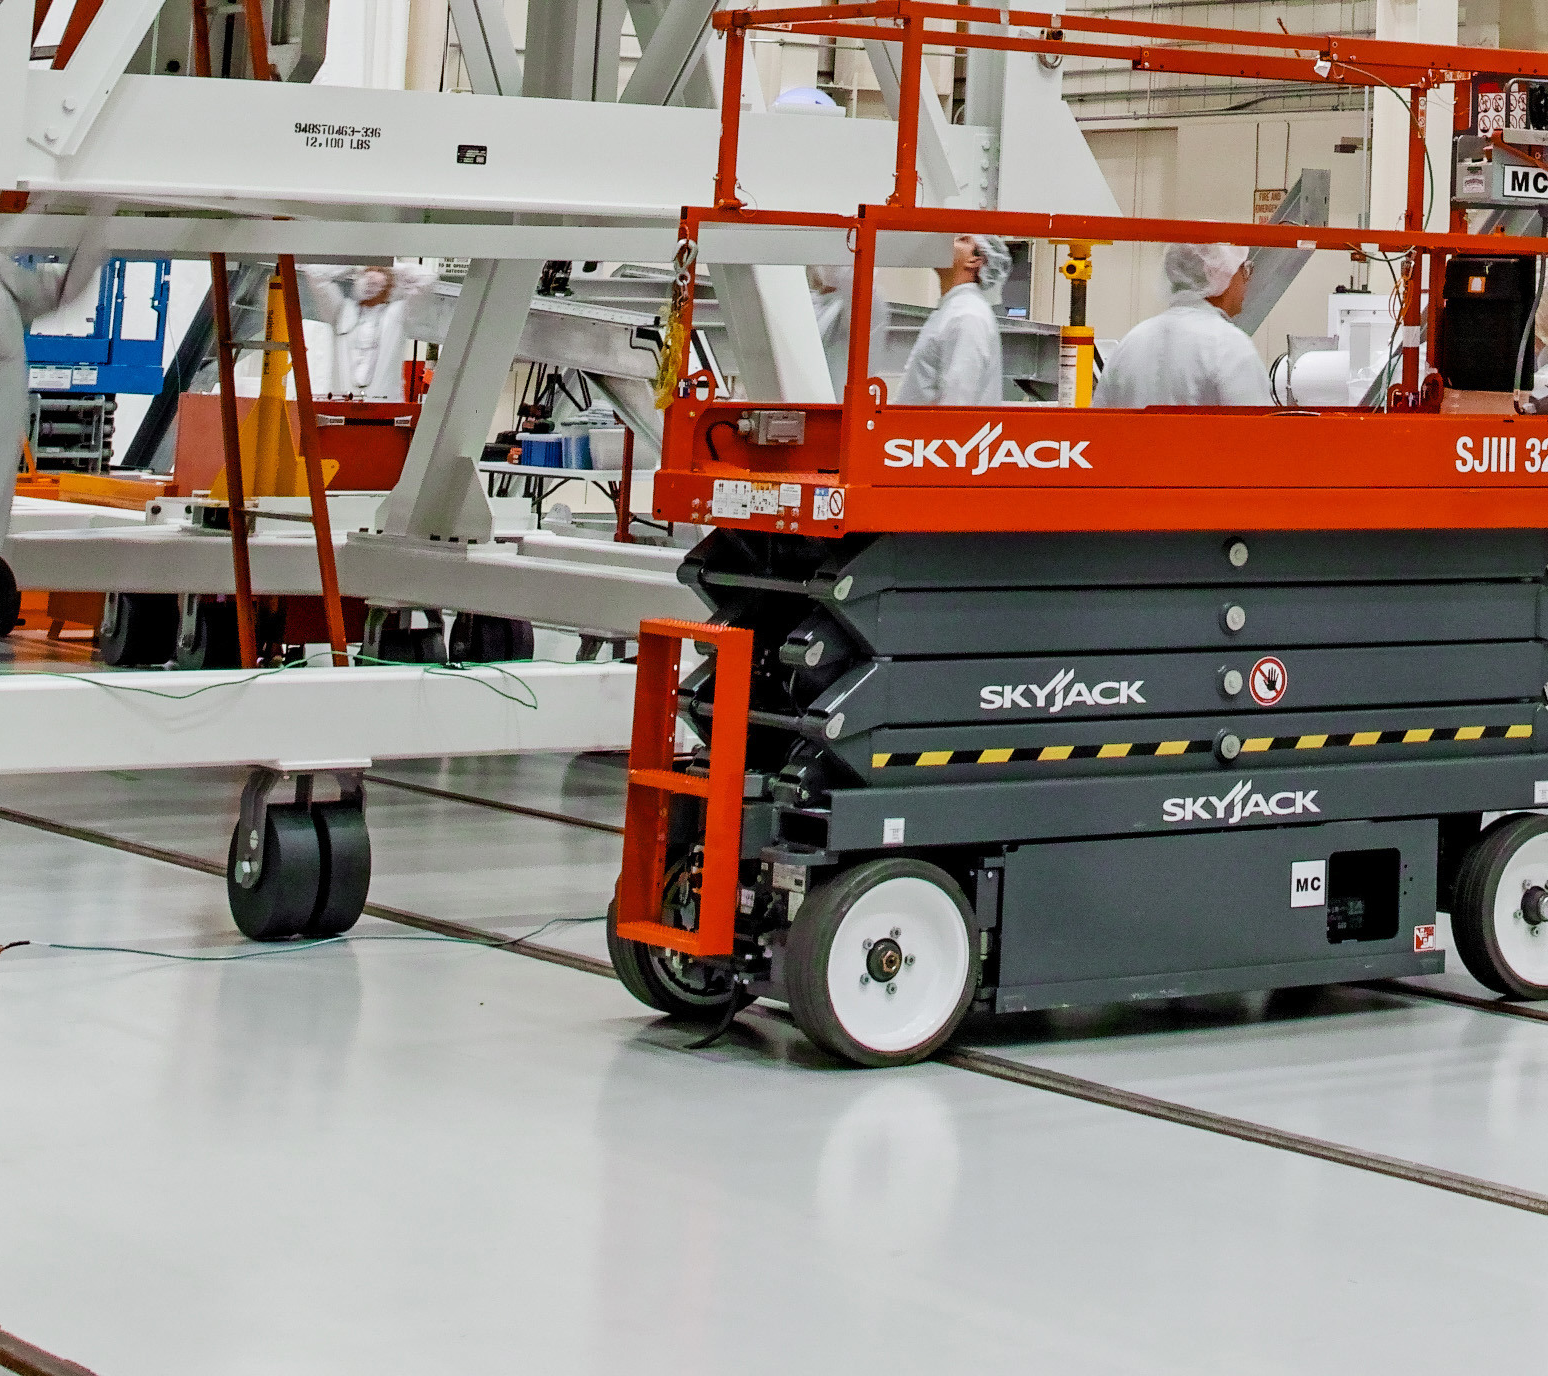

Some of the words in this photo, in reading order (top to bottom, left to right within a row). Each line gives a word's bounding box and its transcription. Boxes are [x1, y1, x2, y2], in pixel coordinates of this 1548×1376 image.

[350, 138, 371, 150] LBS
[1511, 170, 1548, 194] MC
[883, 420, 1094, 477] SKYJACK
[979, 668, 1148, 714] SKYJACK
[1162, 779, 1321, 825] SKYJACK
[1296, 876, 1321, 893] MC
